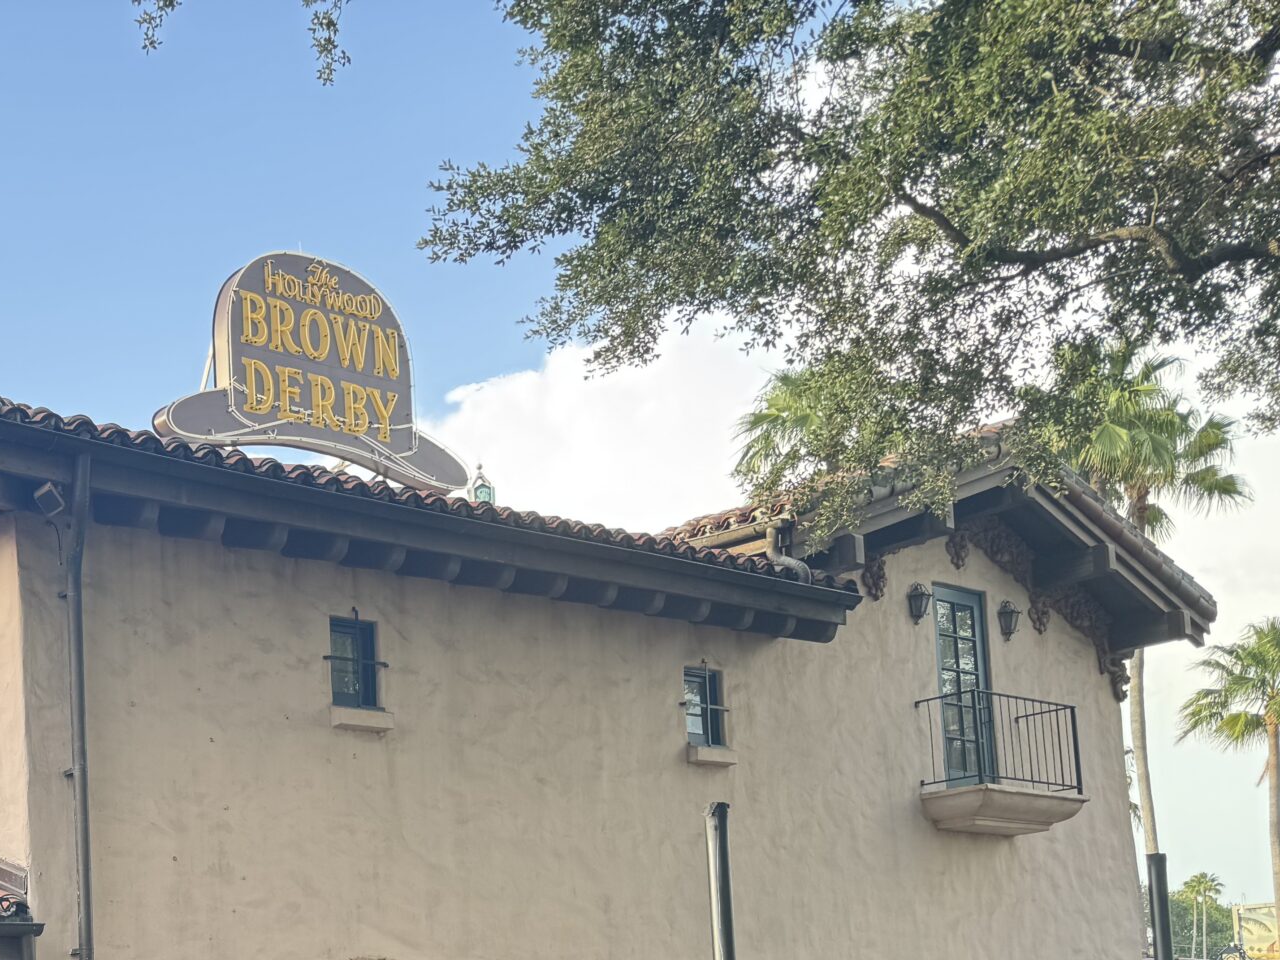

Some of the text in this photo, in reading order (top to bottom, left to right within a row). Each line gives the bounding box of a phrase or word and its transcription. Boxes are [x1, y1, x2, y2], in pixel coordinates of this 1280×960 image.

[264, 260, 383, 320] HOLLYWOOD
[306, 262, 339, 290] The
[239, 289, 400, 380] BROWN
[241, 357, 398, 443] DERBY
